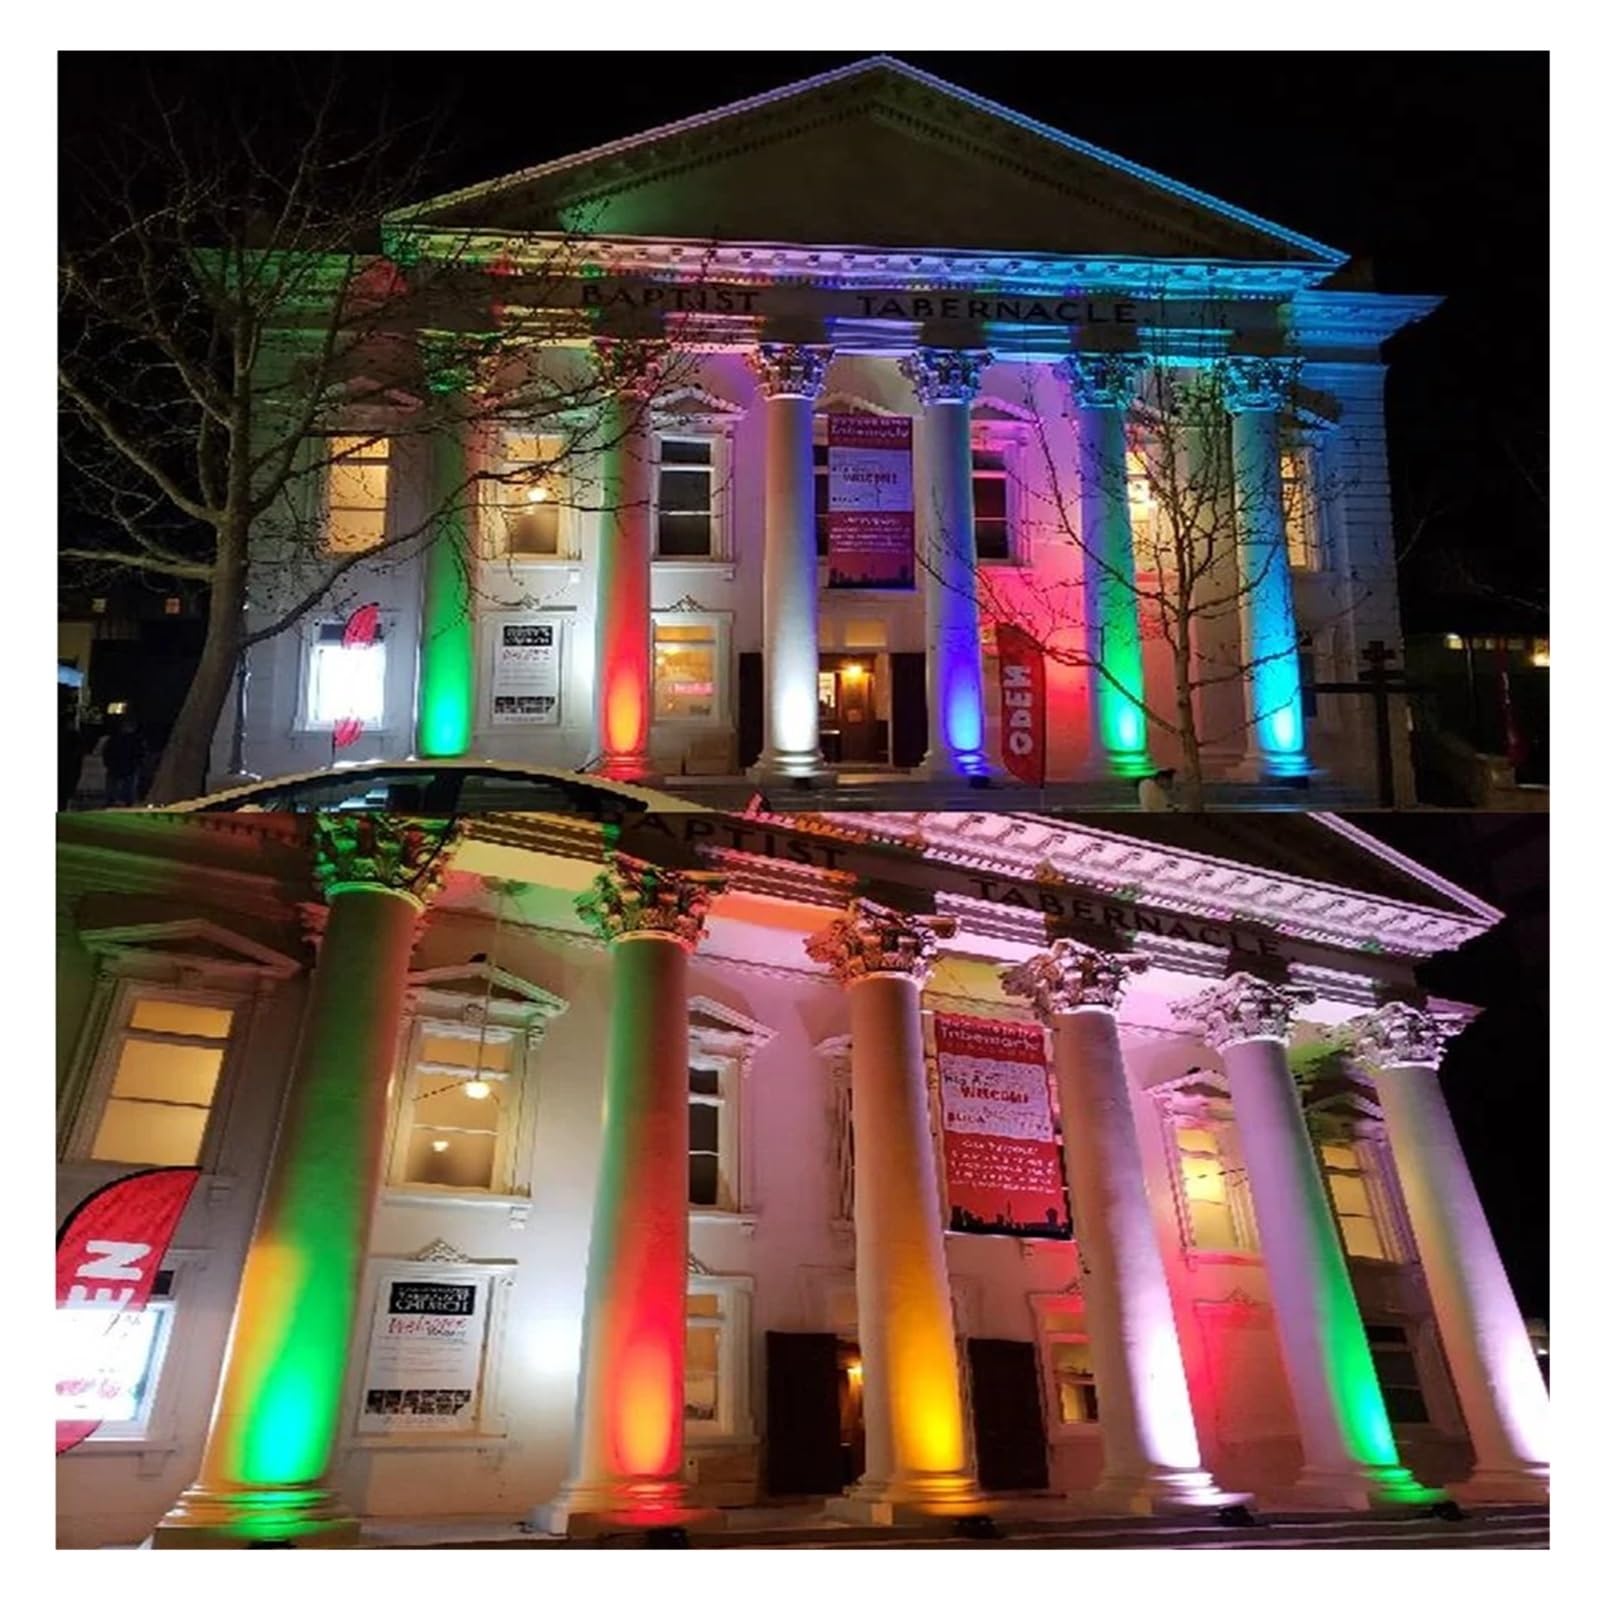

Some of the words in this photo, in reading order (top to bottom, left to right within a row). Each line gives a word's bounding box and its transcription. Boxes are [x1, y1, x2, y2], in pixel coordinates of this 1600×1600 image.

[580, 285, 760, 311] BAPTIST
[857, 295, 1138, 323] TABERNACLE
[1002, 664, 1034, 756] OPEN
[616, 812, 847, 869] APTIST
[970, 877, 1281, 957] TABERNACLE
